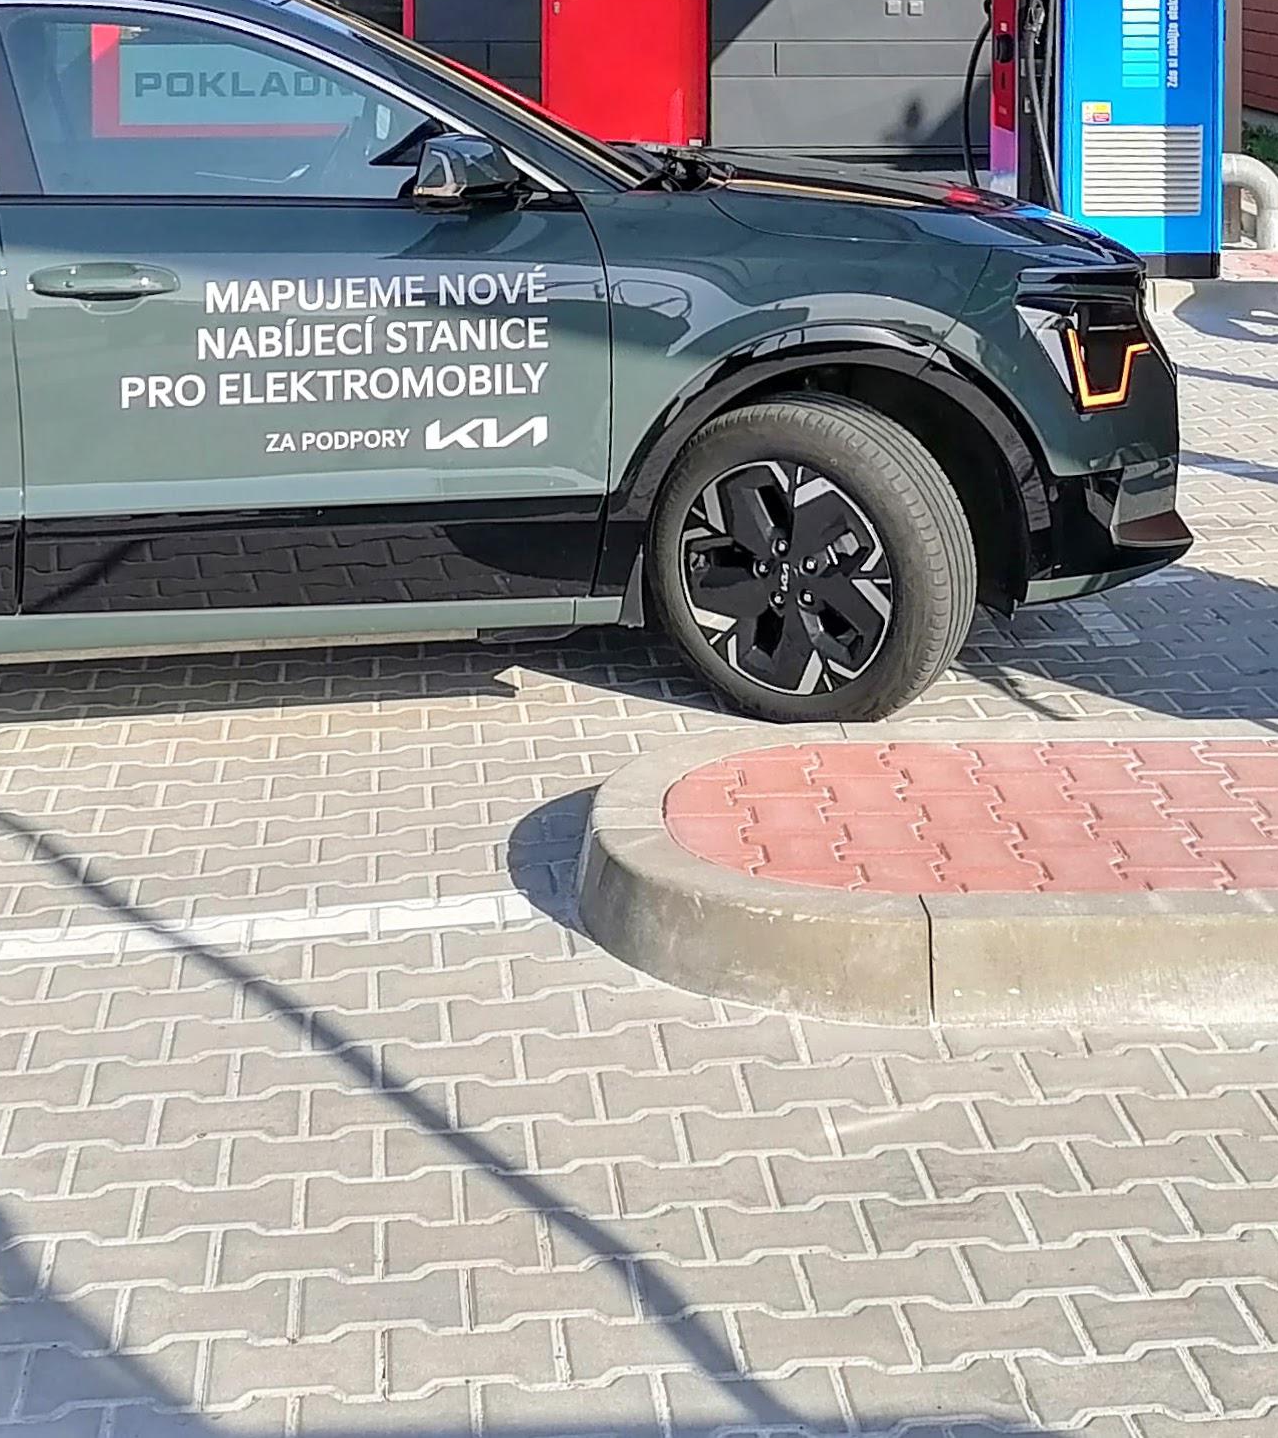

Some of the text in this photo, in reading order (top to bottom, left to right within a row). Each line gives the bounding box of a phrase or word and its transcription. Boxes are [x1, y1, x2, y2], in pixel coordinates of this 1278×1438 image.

[134, 71, 353, 98] POKLADN
[205, 264, 549, 314] MAPUJEME NOVÉ
[196, 316, 549, 361] NABÍJECÍ STANICE
[120, 361, 550, 409] PRO ELEKTROMOBILY
[265, 416, 548, 453] ZA PODPORY KIA
